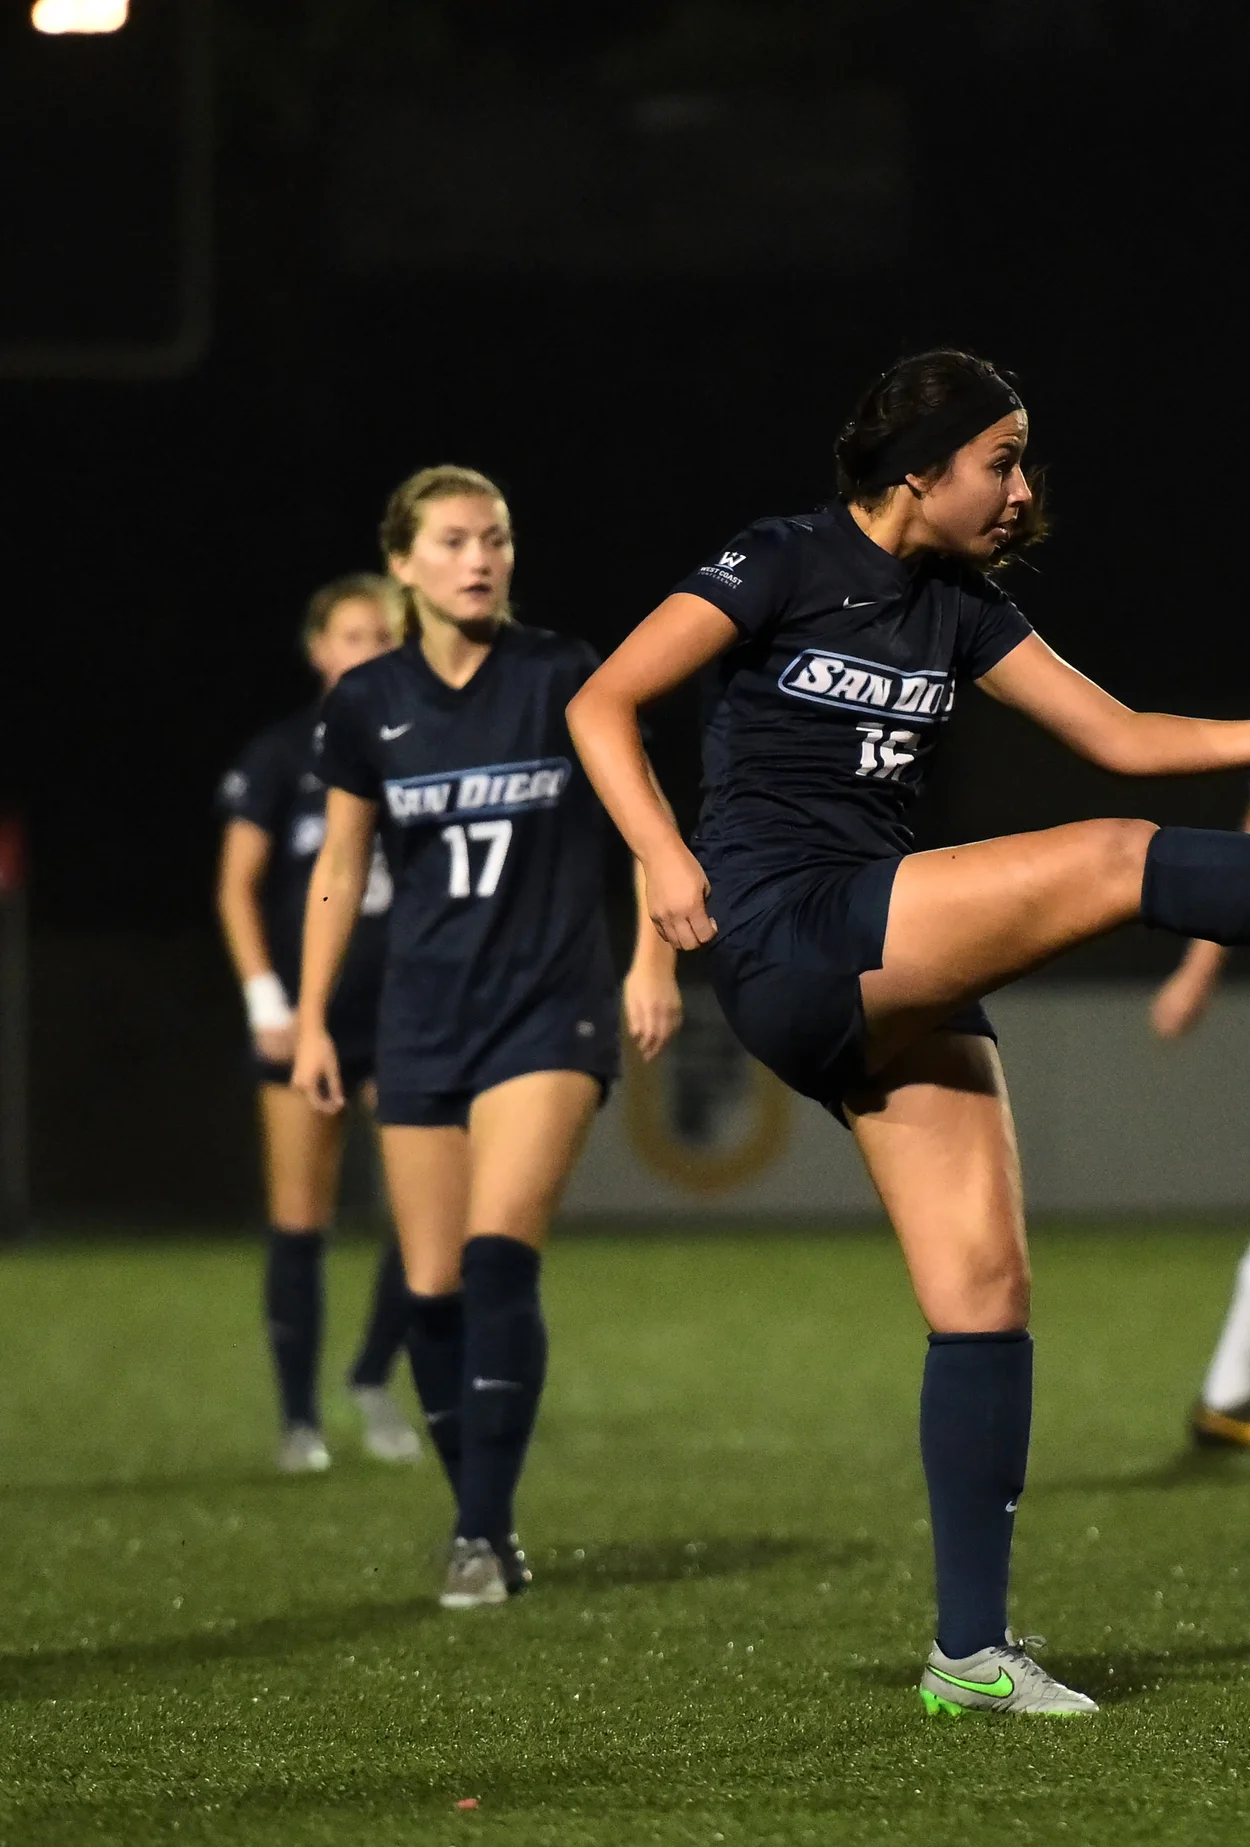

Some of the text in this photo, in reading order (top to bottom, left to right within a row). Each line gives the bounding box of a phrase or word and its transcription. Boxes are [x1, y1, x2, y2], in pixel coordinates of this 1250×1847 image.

[700, 566, 744, 586] WEST COAST
[787, 656, 893, 707] SAN
[440, 819, 513, 899] 17
